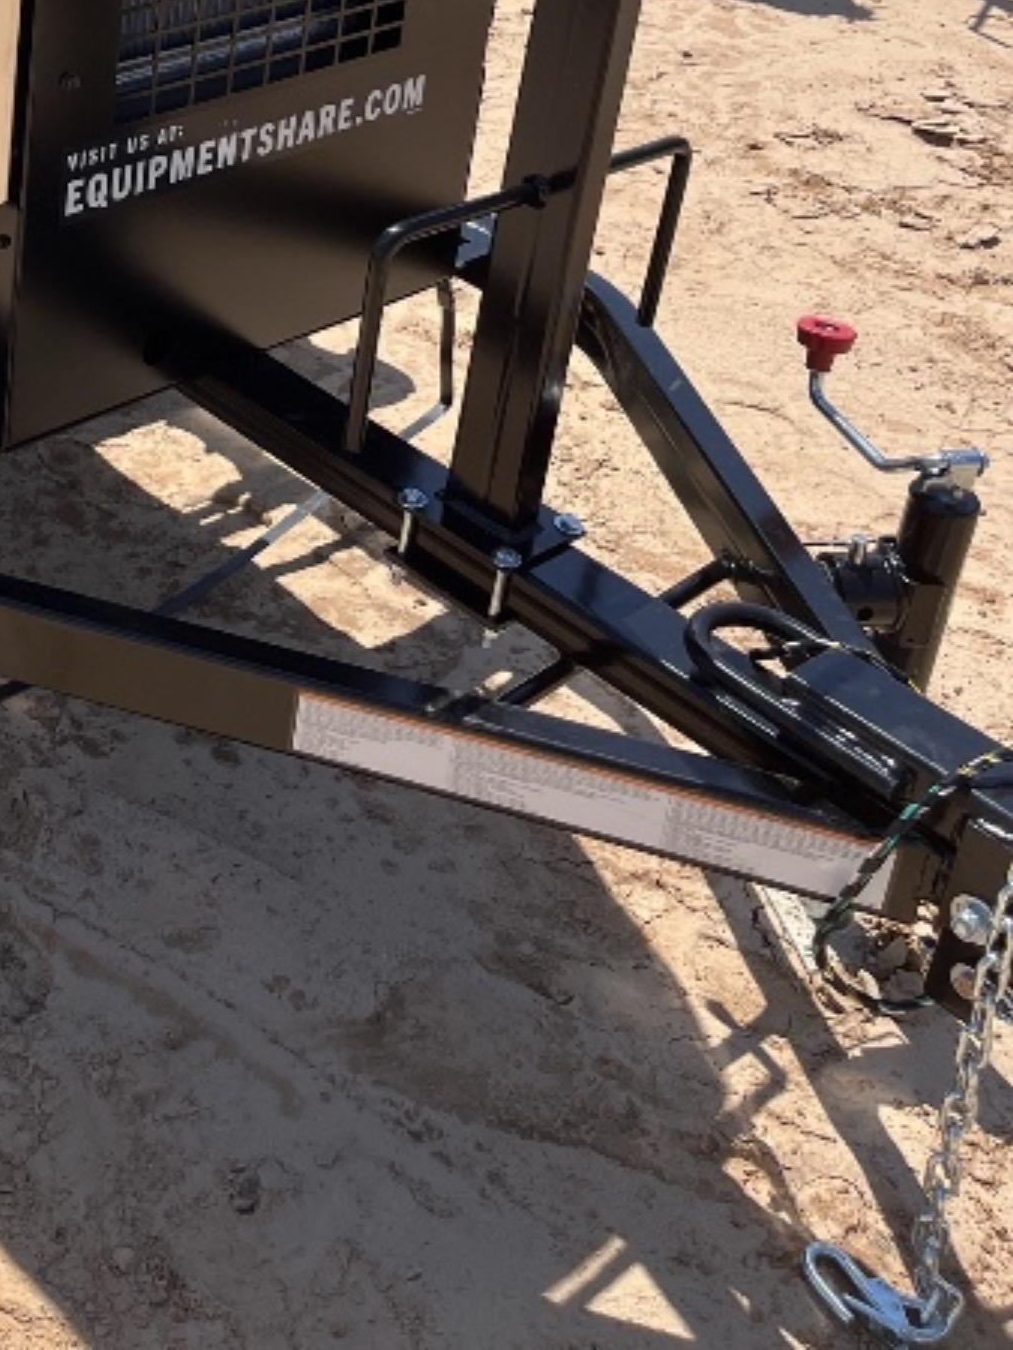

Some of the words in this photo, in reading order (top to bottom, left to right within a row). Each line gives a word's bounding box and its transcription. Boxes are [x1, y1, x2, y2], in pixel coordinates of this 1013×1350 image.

[64, 73, 427, 217] EQUIPMENTSHARE.COM
[67, 143, 117, 171] VISIT
[127, 134, 150, 154] US
